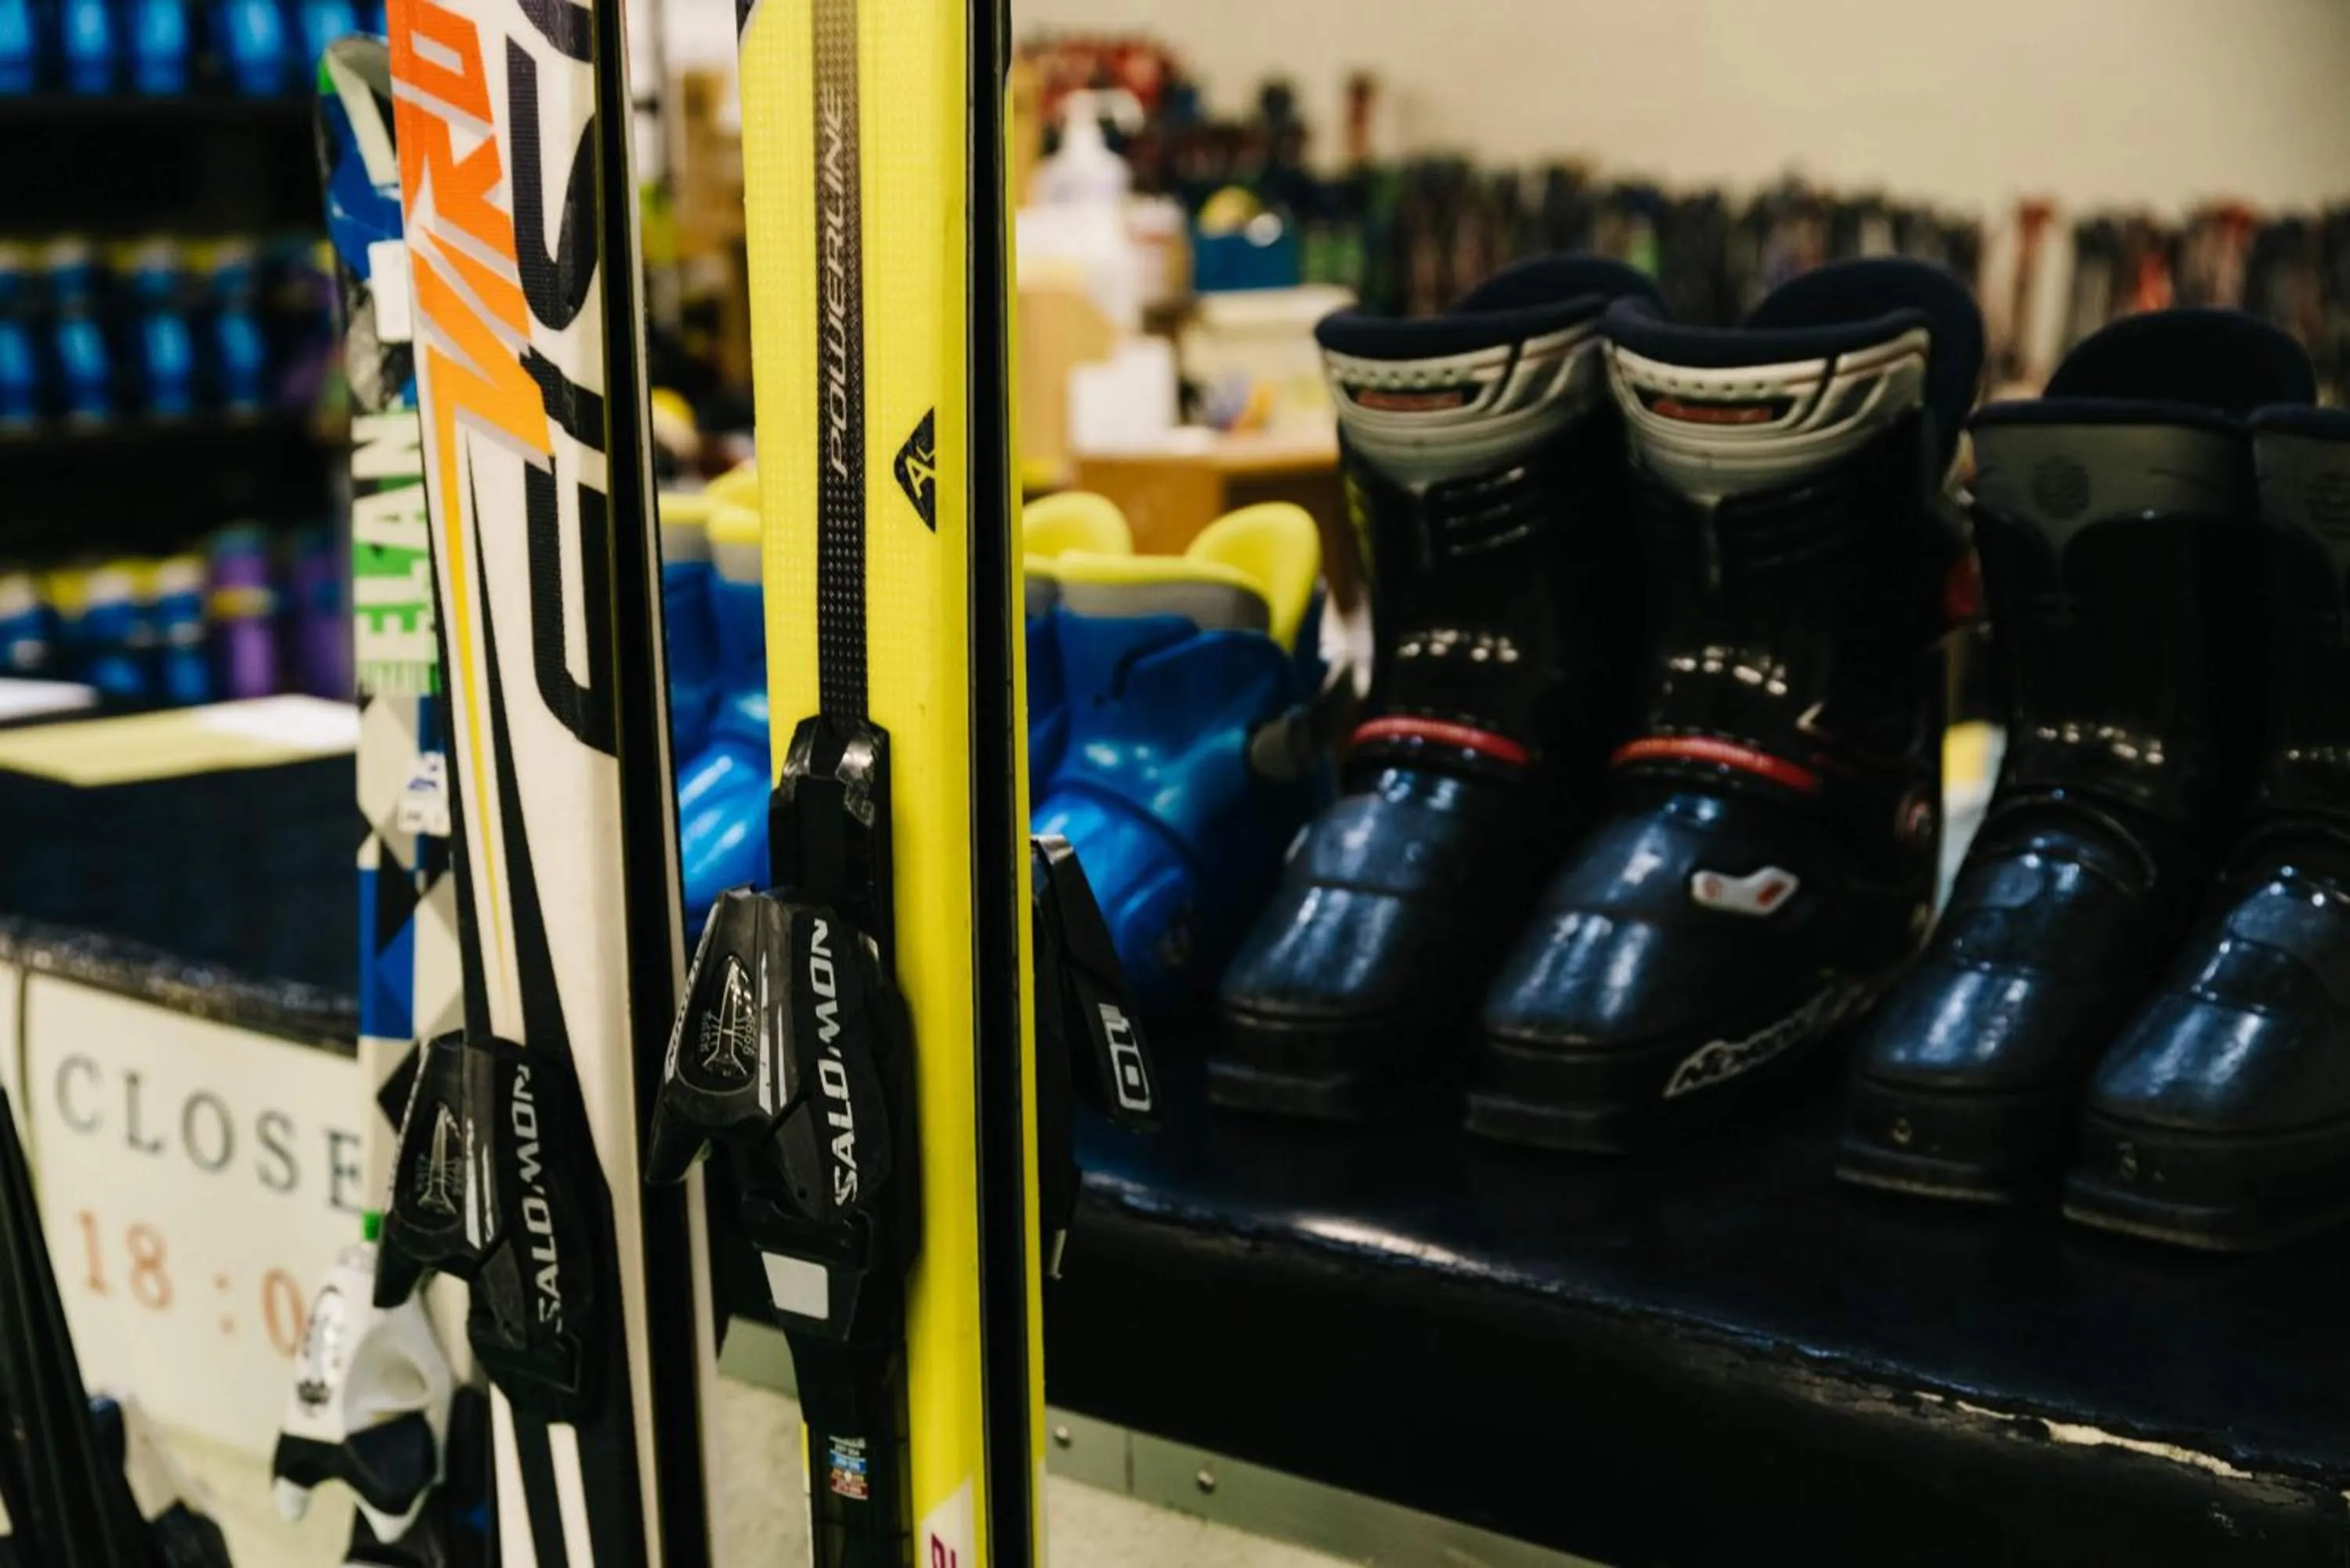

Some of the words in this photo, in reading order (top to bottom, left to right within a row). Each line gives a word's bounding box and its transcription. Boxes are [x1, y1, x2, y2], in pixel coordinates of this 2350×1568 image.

[822, 81, 849, 479] POWERLINE
[351, 411, 436, 663] ELAN
[55, 1052, 366, 1215] CLOSE
[810, 917, 858, 1206] SALOMON
[511, 1063, 562, 1335] SALOMON
